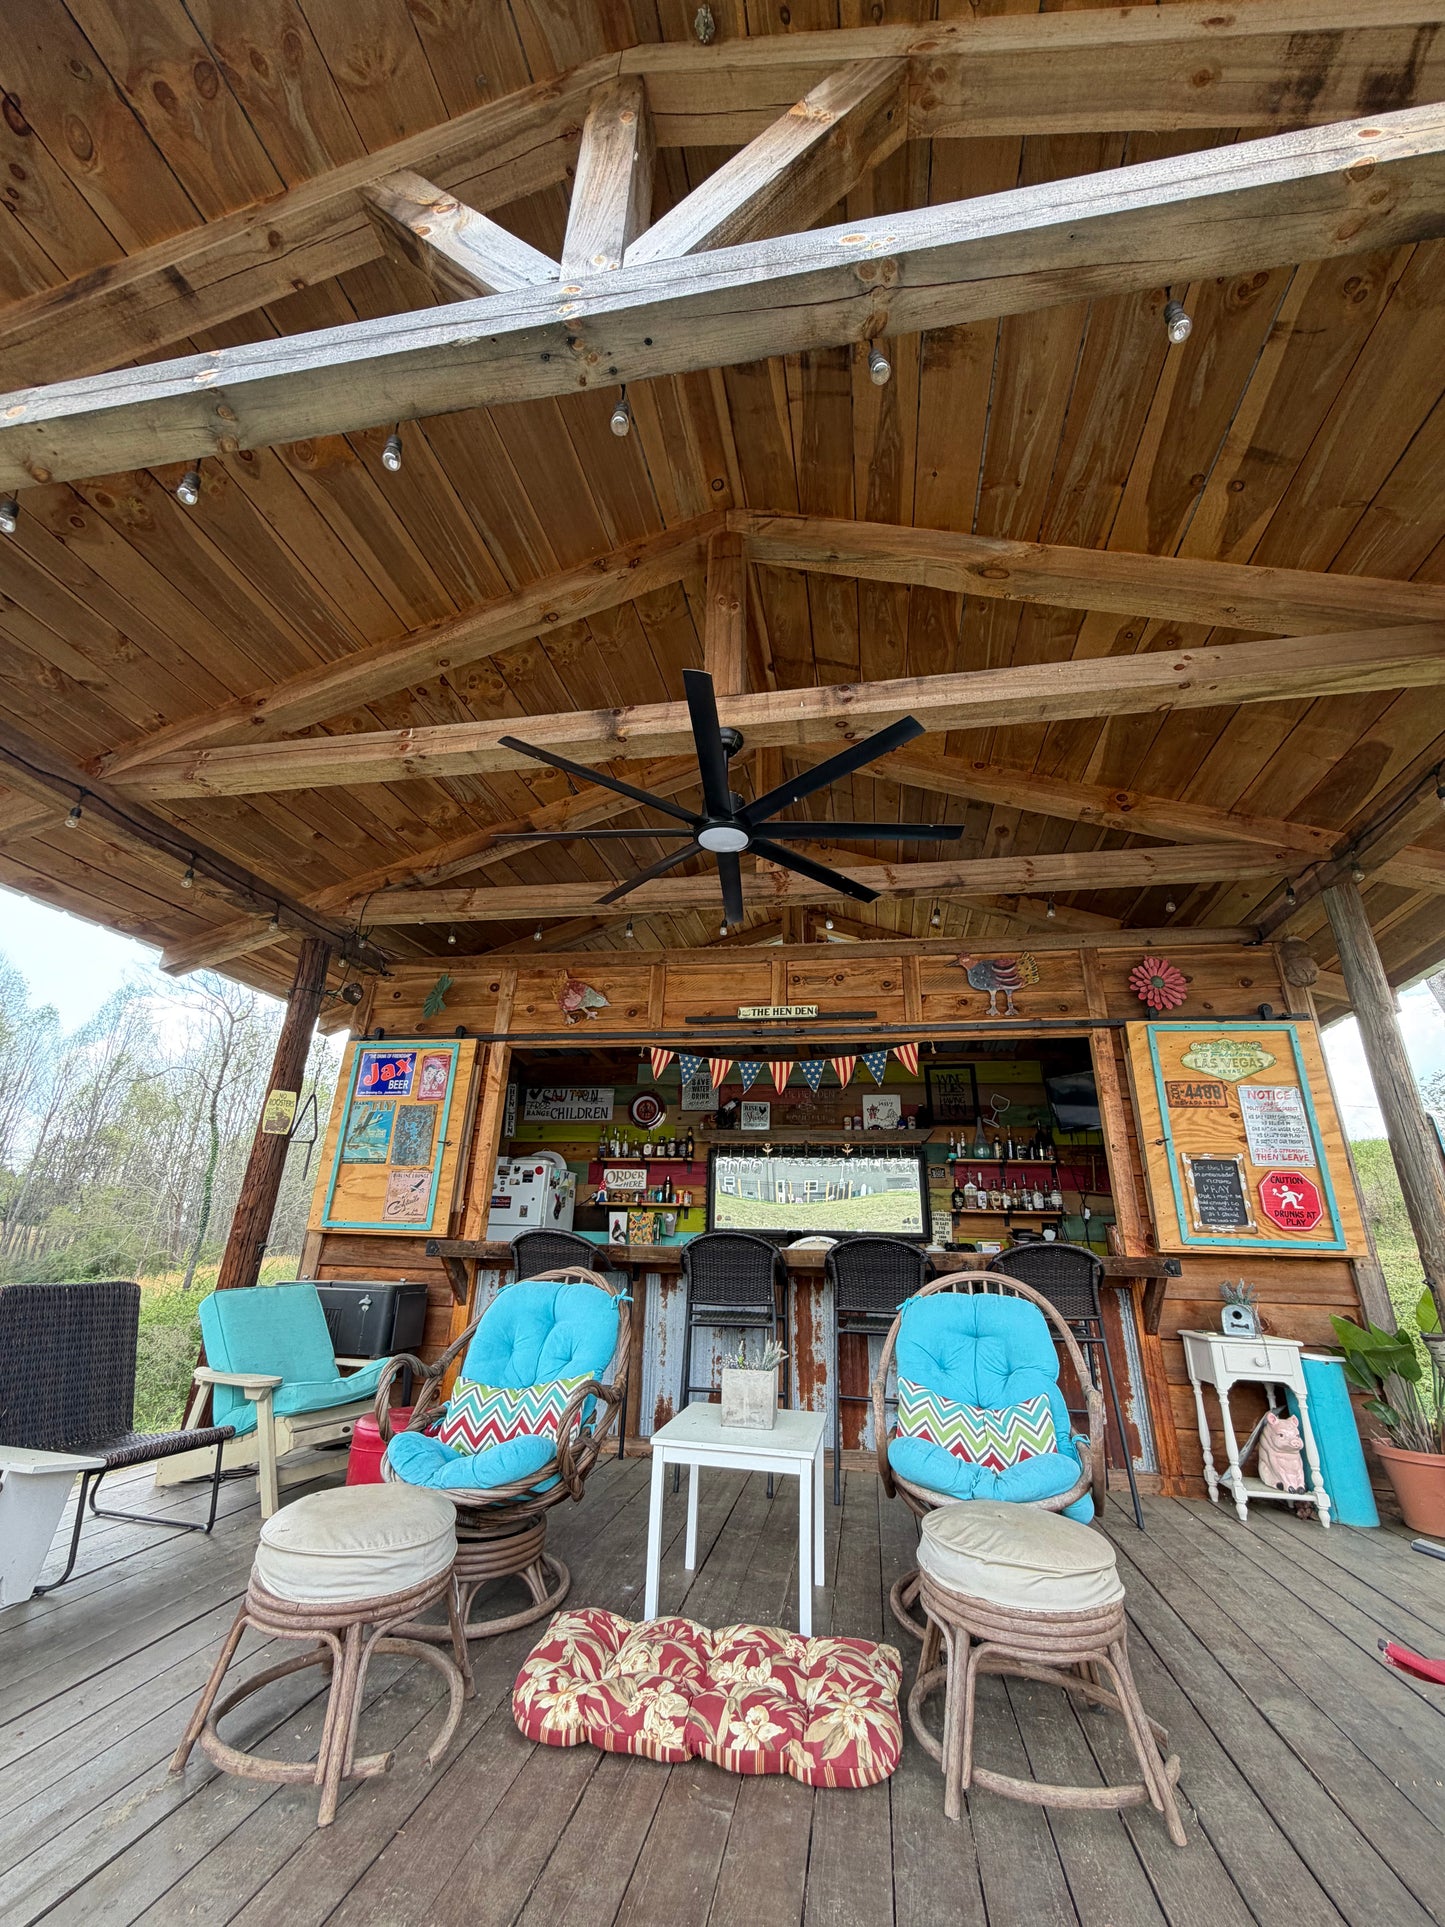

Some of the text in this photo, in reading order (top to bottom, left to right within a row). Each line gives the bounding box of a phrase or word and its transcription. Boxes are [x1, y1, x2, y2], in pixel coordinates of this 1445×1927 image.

[752, 1007, 814, 1017] THE HEN DEN
[1194, 1058, 1264, 1069] LAS VEGAS
[363, 1058, 413, 1087] Jax
[388, 1079, 409, 1090] BEER
[692, 1078, 710, 1086] SAVE
[1247, 1090, 1291, 1101] NOTICE
[269, 1098, 295, 1107] ROOSTERS
[527, 1109, 551, 1117] RANGE
[550, 1107, 609, 1119] CHILDREN
[1281, 1154, 1310, 1162] LEAVE
[606, 1170, 644, 1184] ORDER
[1270, 1176, 1304, 1185] CAUTION
[623, 1180, 644, 1188] HERE
[1202, 1184, 1230, 1194] PRAY
[1274, 1210, 1305, 1218] DRUNKS
[1286, 1218, 1306, 1226] PLAY
